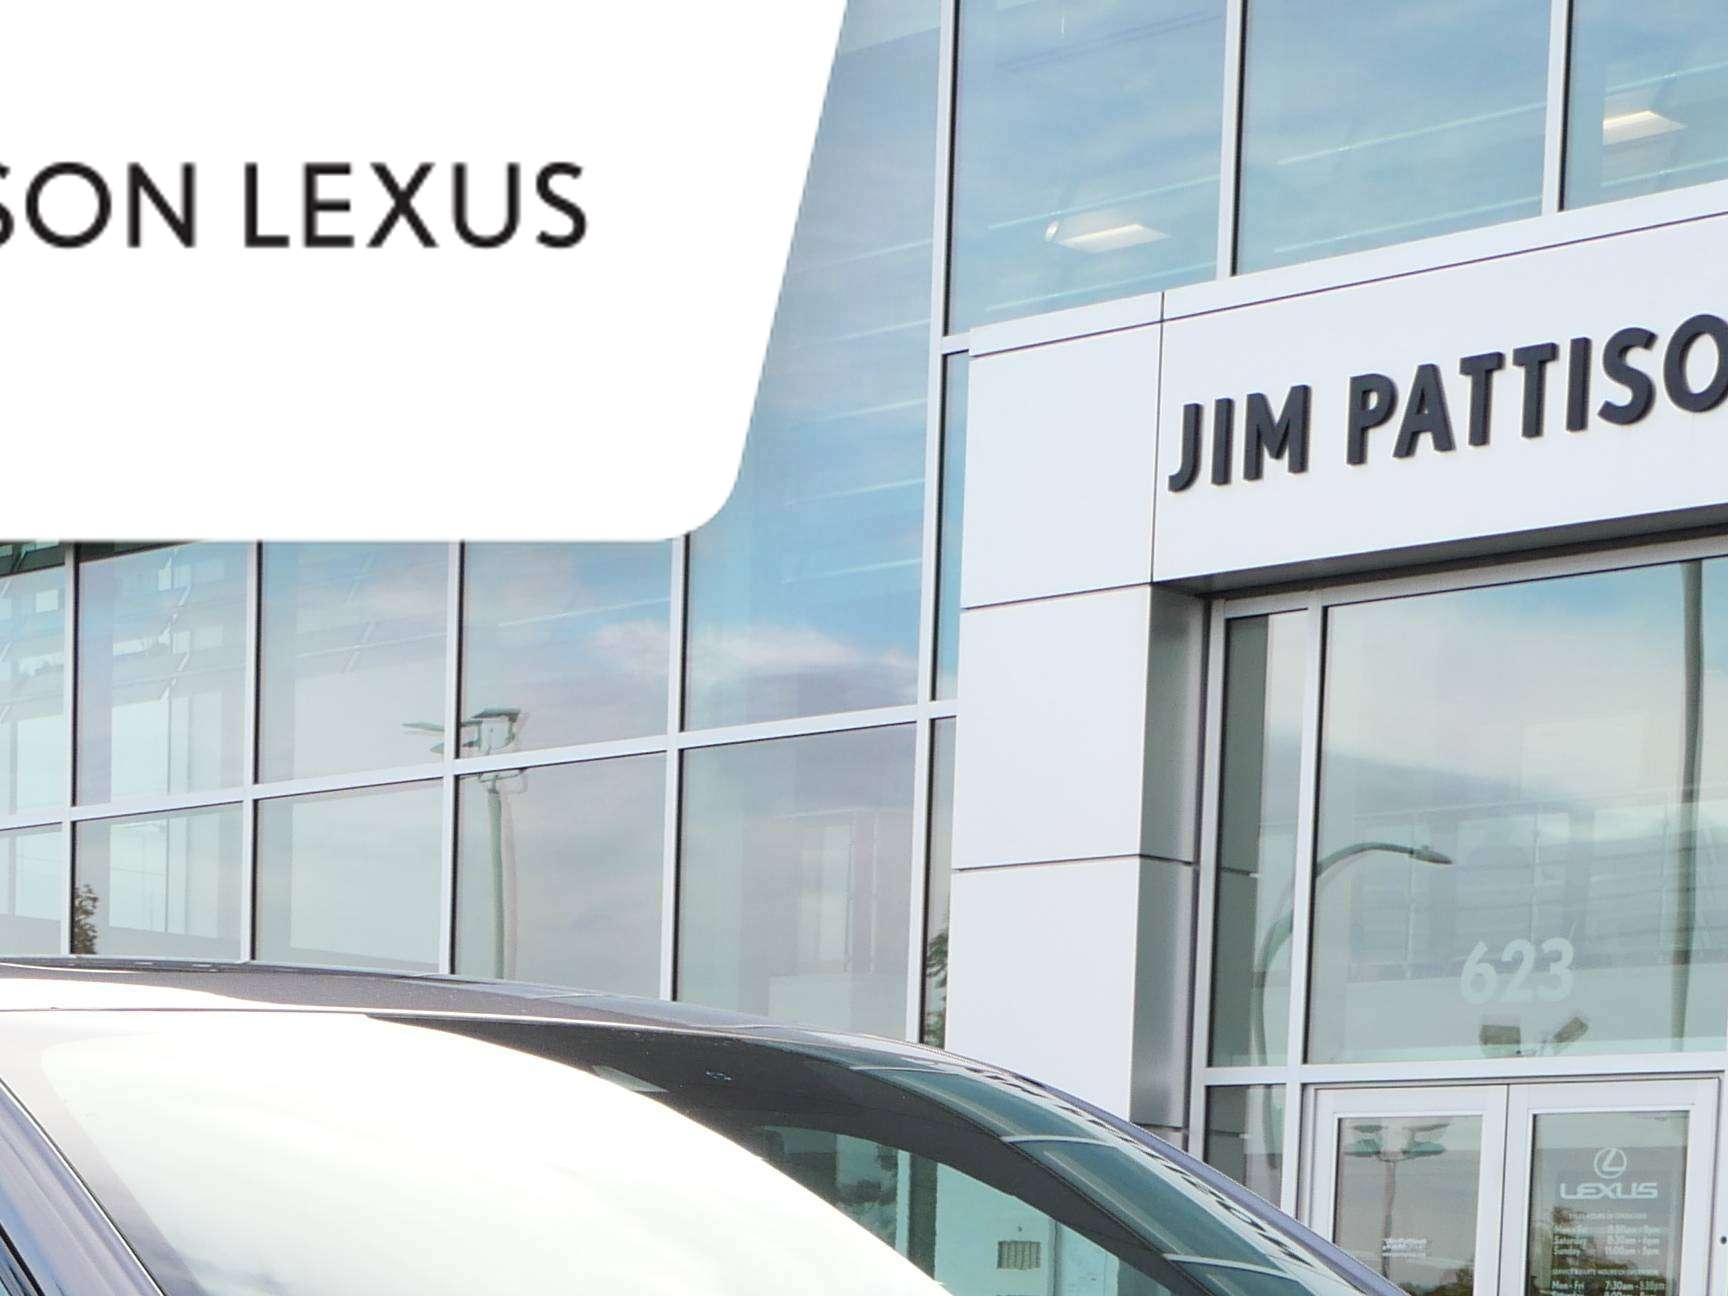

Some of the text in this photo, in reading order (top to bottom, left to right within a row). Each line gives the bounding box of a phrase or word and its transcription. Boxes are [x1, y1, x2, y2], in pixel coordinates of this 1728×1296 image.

[1168, 385, 1312, 493] JIM
[1460, 937, 1574, 1005] 623
[1560, 1182, 1658, 1200] LEXUS
